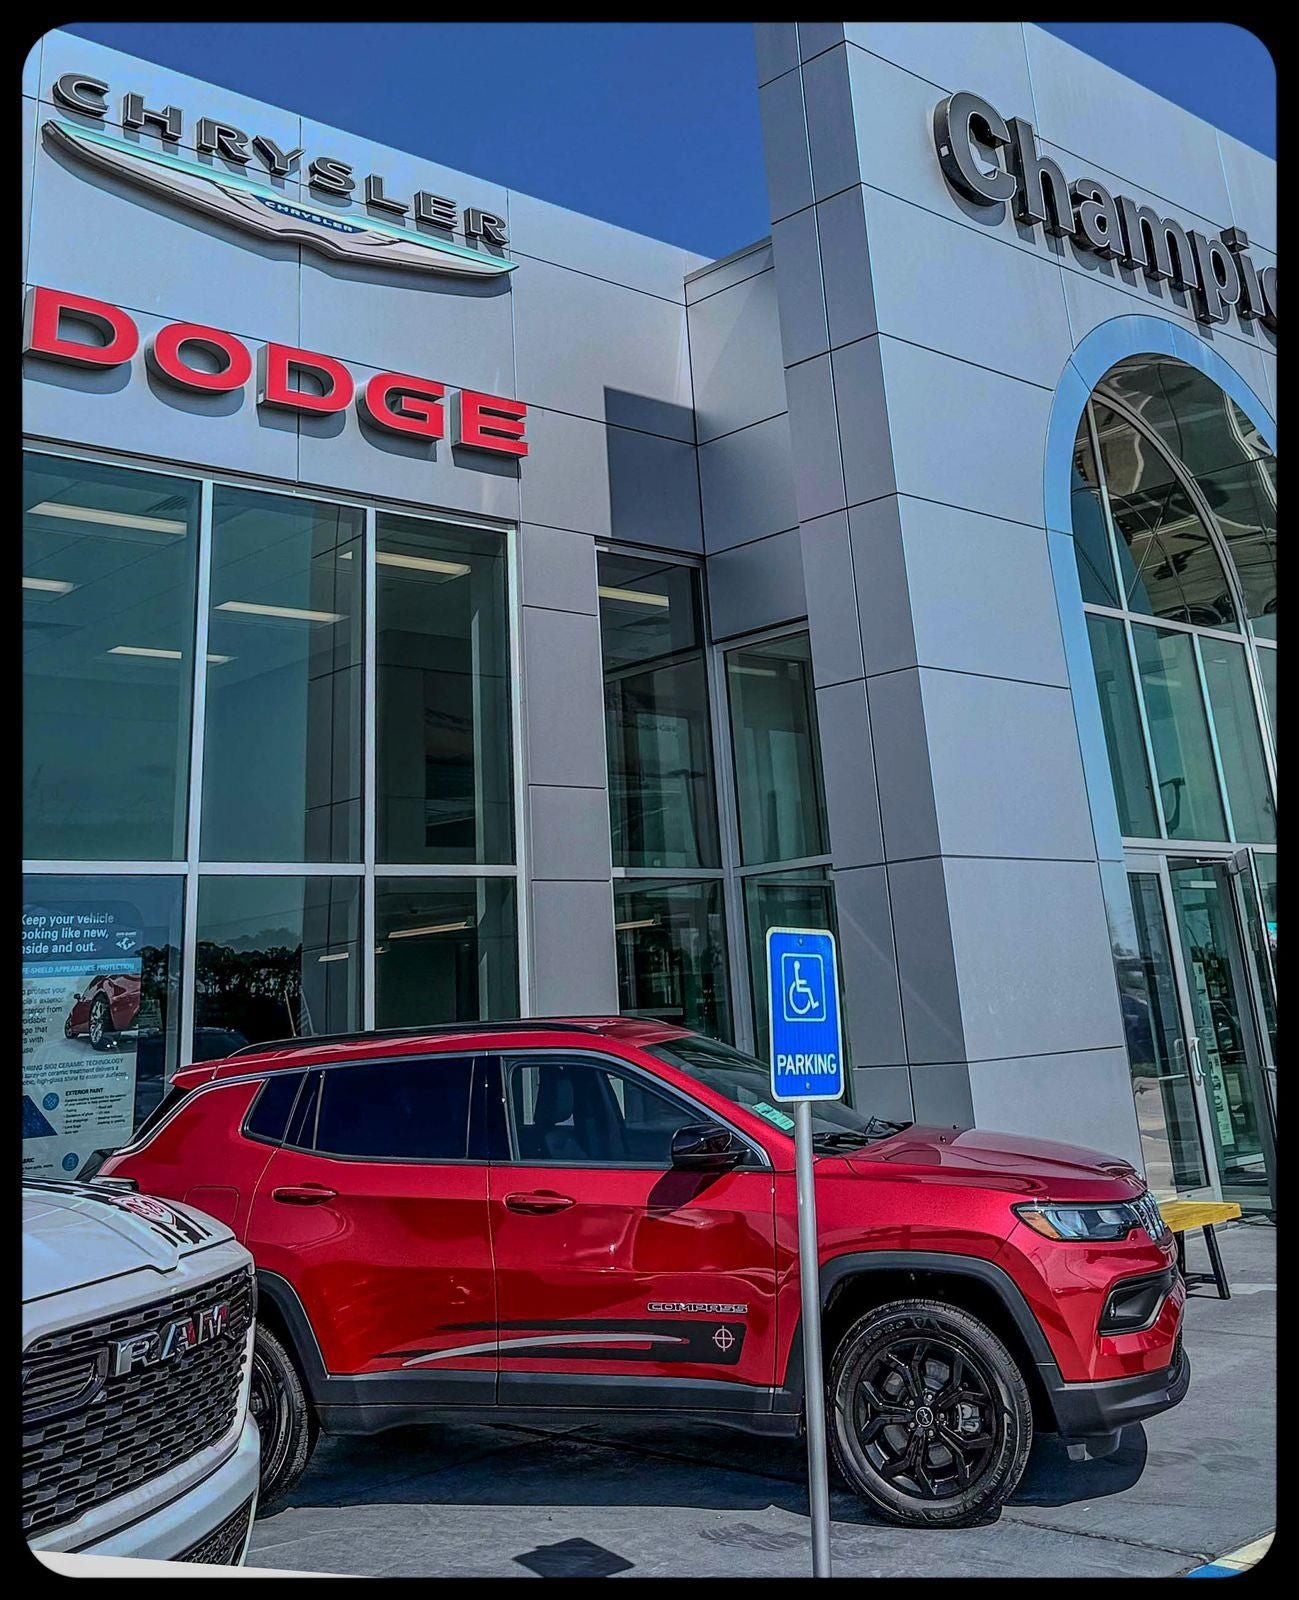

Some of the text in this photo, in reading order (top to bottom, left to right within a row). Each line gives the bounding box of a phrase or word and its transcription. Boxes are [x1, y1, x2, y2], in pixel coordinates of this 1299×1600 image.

[52, 72, 511, 246] CHRYSLER
[264, 200, 353, 233] CHRYSLER
[24, 285, 529, 457] DODGE
[50, 914, 75, 927] your
[77, 912, 114, 924] vehicle
[22, 928, 58, 941] ooking
[62, 927, 80, 939] like
[83, 929, 109, 939] new,
[52, 942, 73, 953] and
[75, 943, 97, 953] out.
[54, 964, 97, 974] APPEARANCE
[97, 963, 134, 971] PROTECTION
[777, 1053, 837, 1076] PARKING
[65, 1088, 89, 1096] EXTERIOR
[647, 1302, 748, 1313] COMPASS
[107, 1303, 231, 1378] RAM
